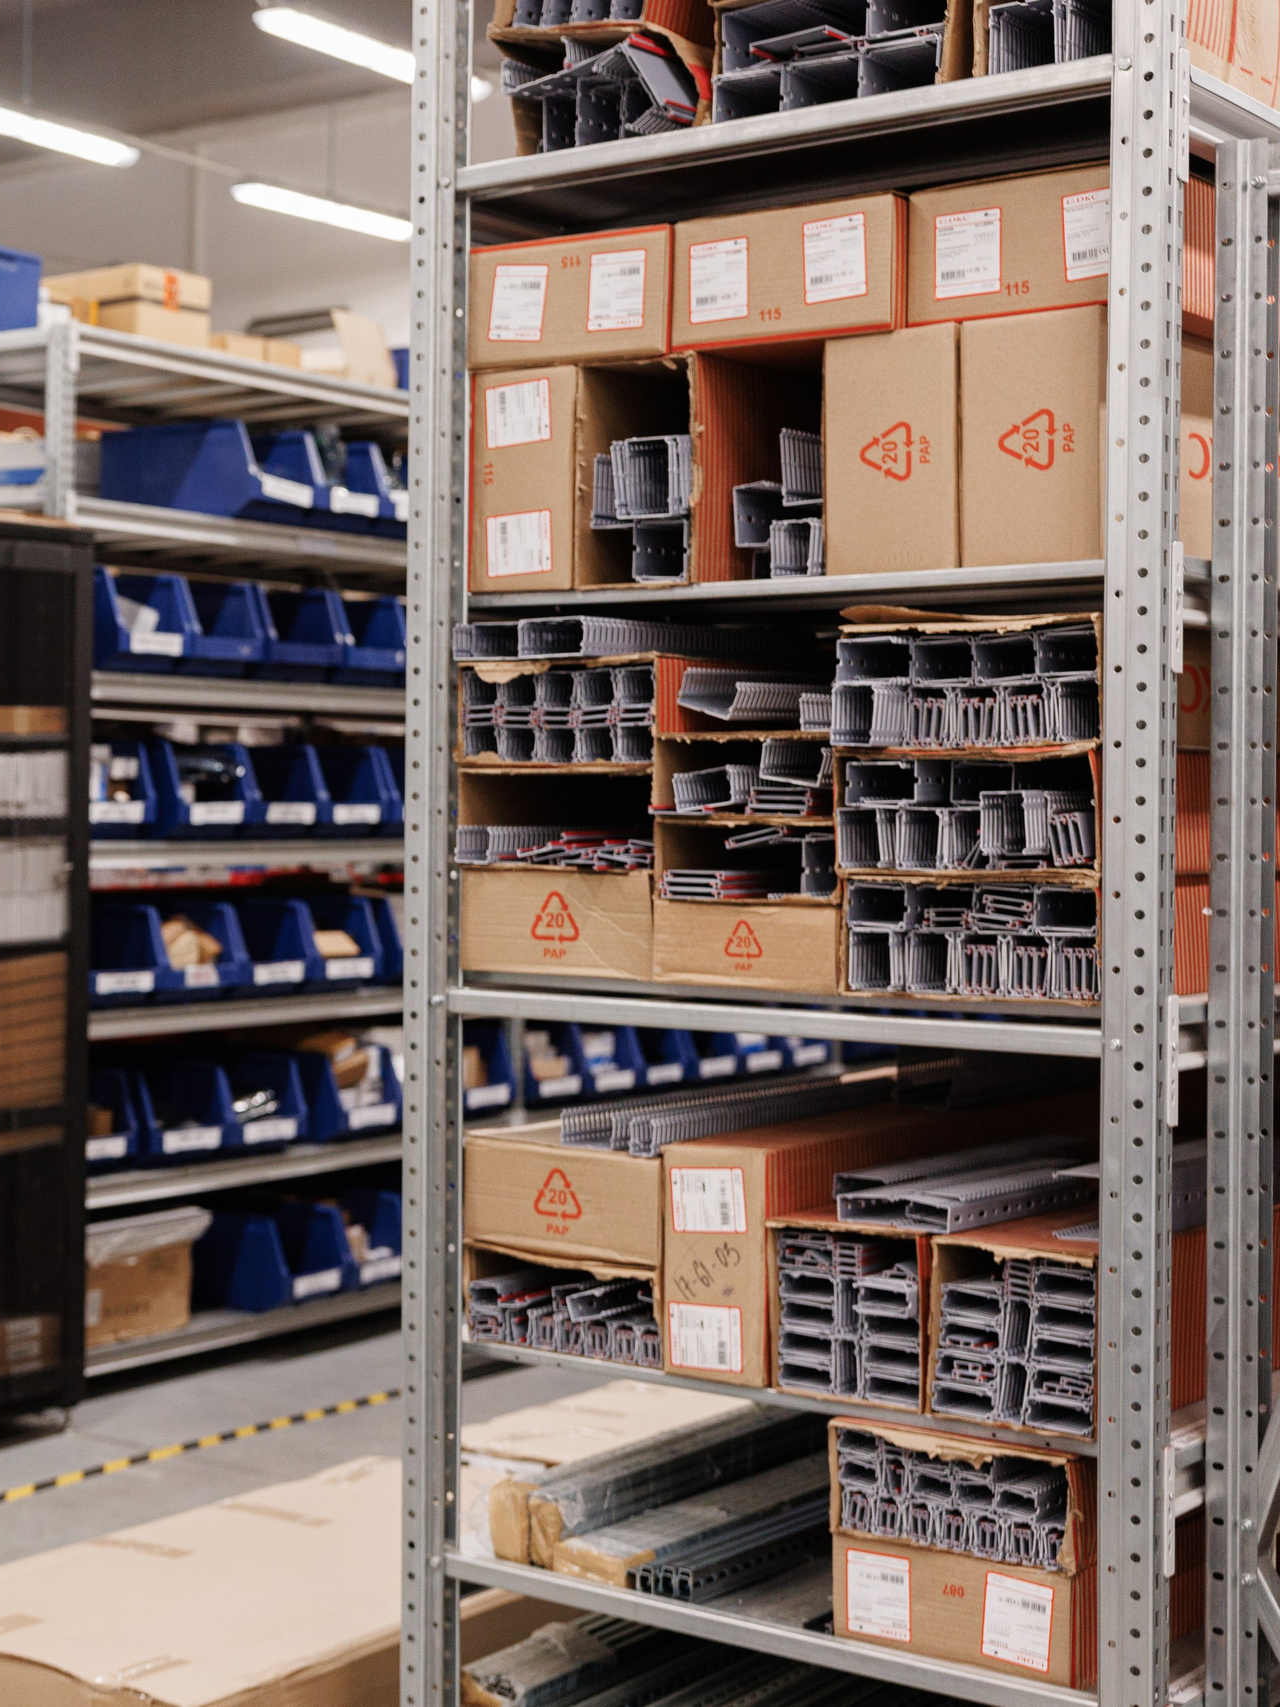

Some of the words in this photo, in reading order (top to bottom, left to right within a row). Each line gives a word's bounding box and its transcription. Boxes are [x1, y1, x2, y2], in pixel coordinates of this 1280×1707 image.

[1005, 279, 1030, 296] 115
[758, 306, 782, 321] 115
[1022, 428, 1040, 453] 20
[1062, 422, 1076, 454] PAP
[882, 440, 898, 464] 20
[919, 435, 931, 464] PAP
[482, 462, 495, 486] 115
[545, 912, 565, 929] 20
[734, 935, 752, 949] 20
[542, 947, 567, 960] PAP
[734, 962, 753, 972] PAP
[548, 1188, 568, 1205] 20
[545, 1221, 570, 1236] PAP
[941, 1583, 965, 1599] 087
